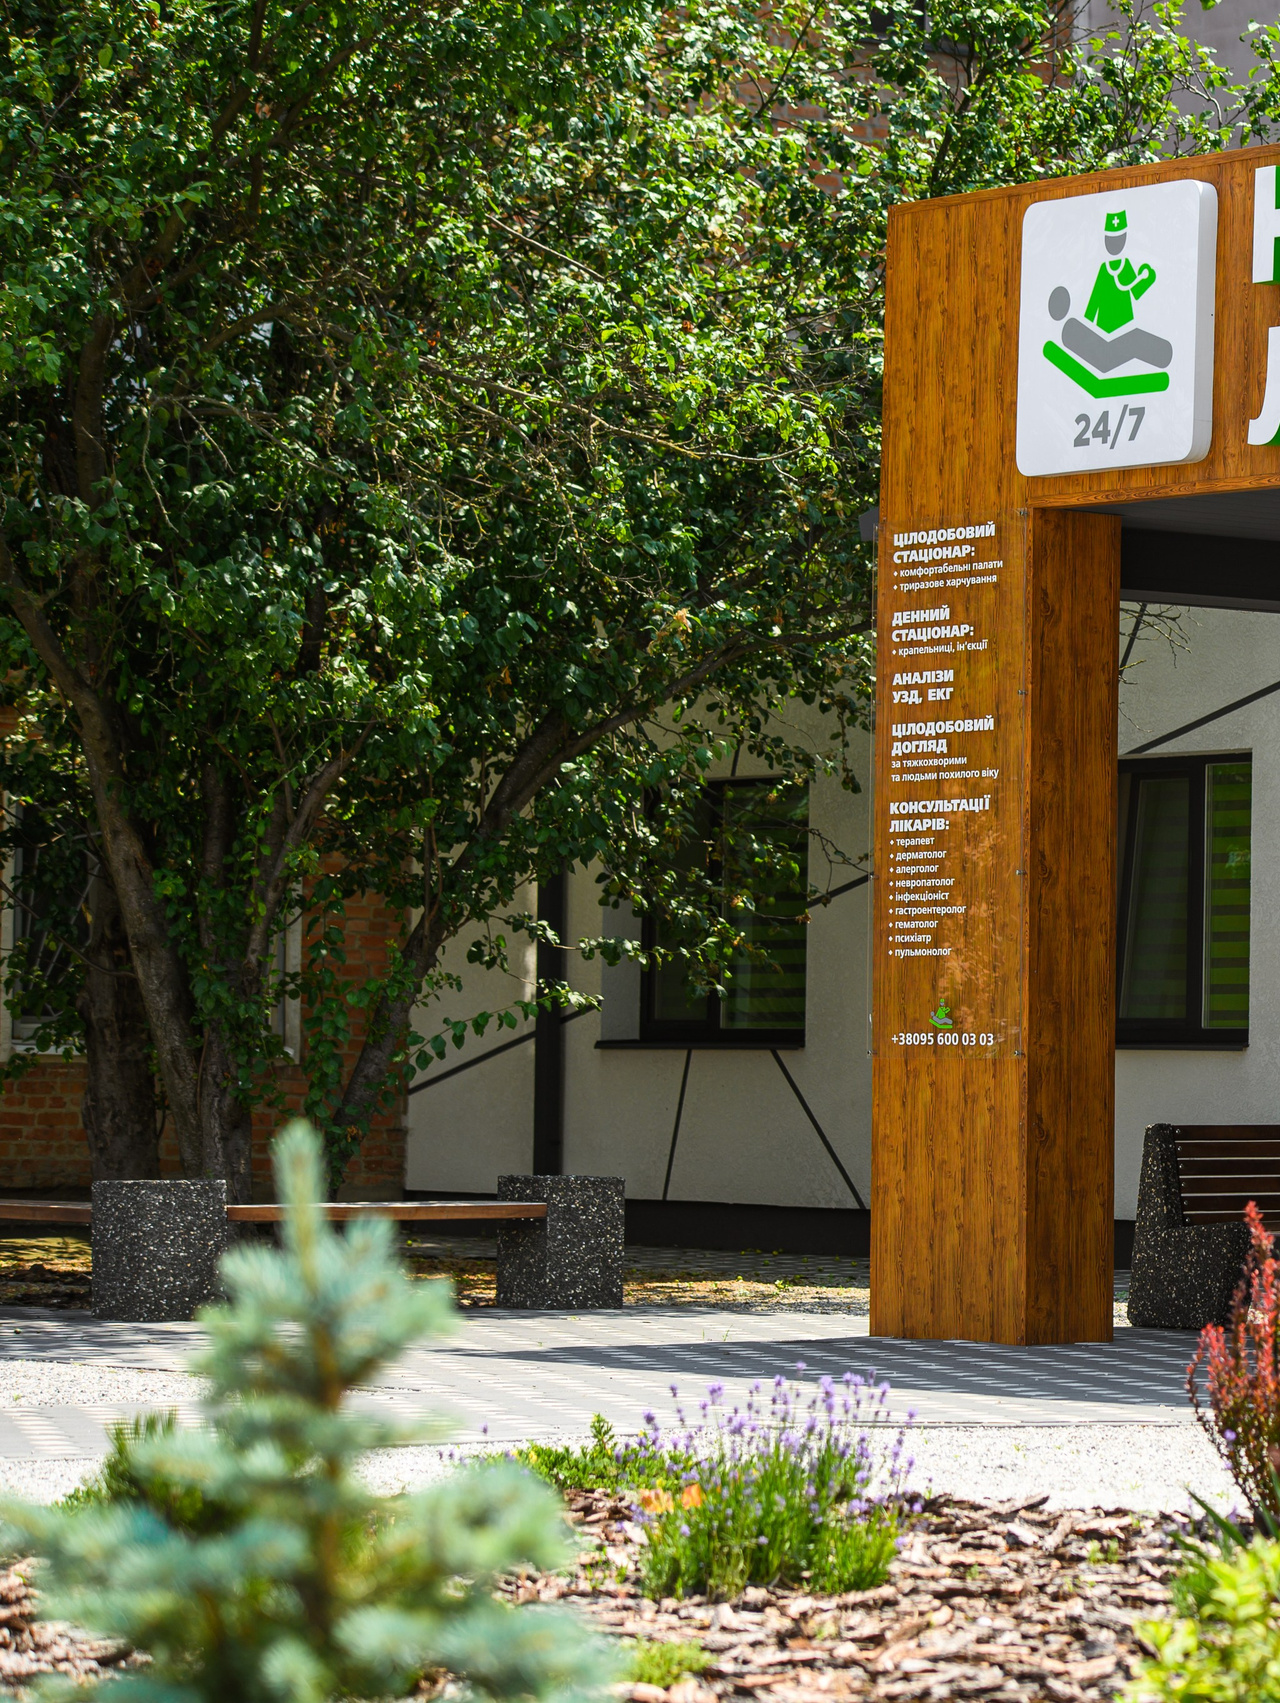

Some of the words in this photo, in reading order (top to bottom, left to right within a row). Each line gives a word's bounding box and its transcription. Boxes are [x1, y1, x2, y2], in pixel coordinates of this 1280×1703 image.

[1073, 404, 1146, 450] 24/7
[893, 521, 996, 548] ЦІЛОДОБОВИЙ
[893, 544, 975, 564] СТАЦІОНАР:
[900, 563, 971, 578] комфортабельні
[972, 560, 1004, 571] палати
[900, 580, 944, 593] триразове
[945, 574, 997, 588] харчування
[891, 604, 950, 627] ДЕННИЙ
[891, 624, 974, 642] СТАЦІОНАР:
[898, 642, 955, 658] крапельниці,
[892, 669, 954, 686] АНАЛІЗИ
[892, 689, 923, 705] УЗД,
[927, 687, 954, 701] ЕКГ
[892, 714, 994, 738] ЦІЛОДОБОВИЙ
[891, 739, 947, 757] ДОГЛЯД
[891, 760, 901, 769] за
[902, 756, 967, 768] тяжкохворими
[891, 774, 900, 782] та
[901, 771, 937, 782] людьми
[939, 770, 980, 780] похилого
[981, 767, 999, 780] віку
[889, 794, 991, 815] КОНСУЛЬТАЦІЇ
[889, 818, 950, 833] ЛІКАРІВ:
[896, 837, 935, 848] терапевт
[895, 850, 947, 862] дерматолог
[895, 864, 939, 875] алерголог
[895, 878, 955, 889] невропатолог
[895, 891, 950, 903] інфекціоніст
[895, 905, 967, 917] гастроентеролог
[895, 920, 938, 929] гематолог
[894, 933, 932, 944] психіатр
[894, 948, 952, 959] пульмонолог
[891, 1032, 934, 1045] +38095
[937, 1032, 959, 1045] 600
[962, 1033, 976, 1045] 03
[979, 1033, 994, 1045] 03
